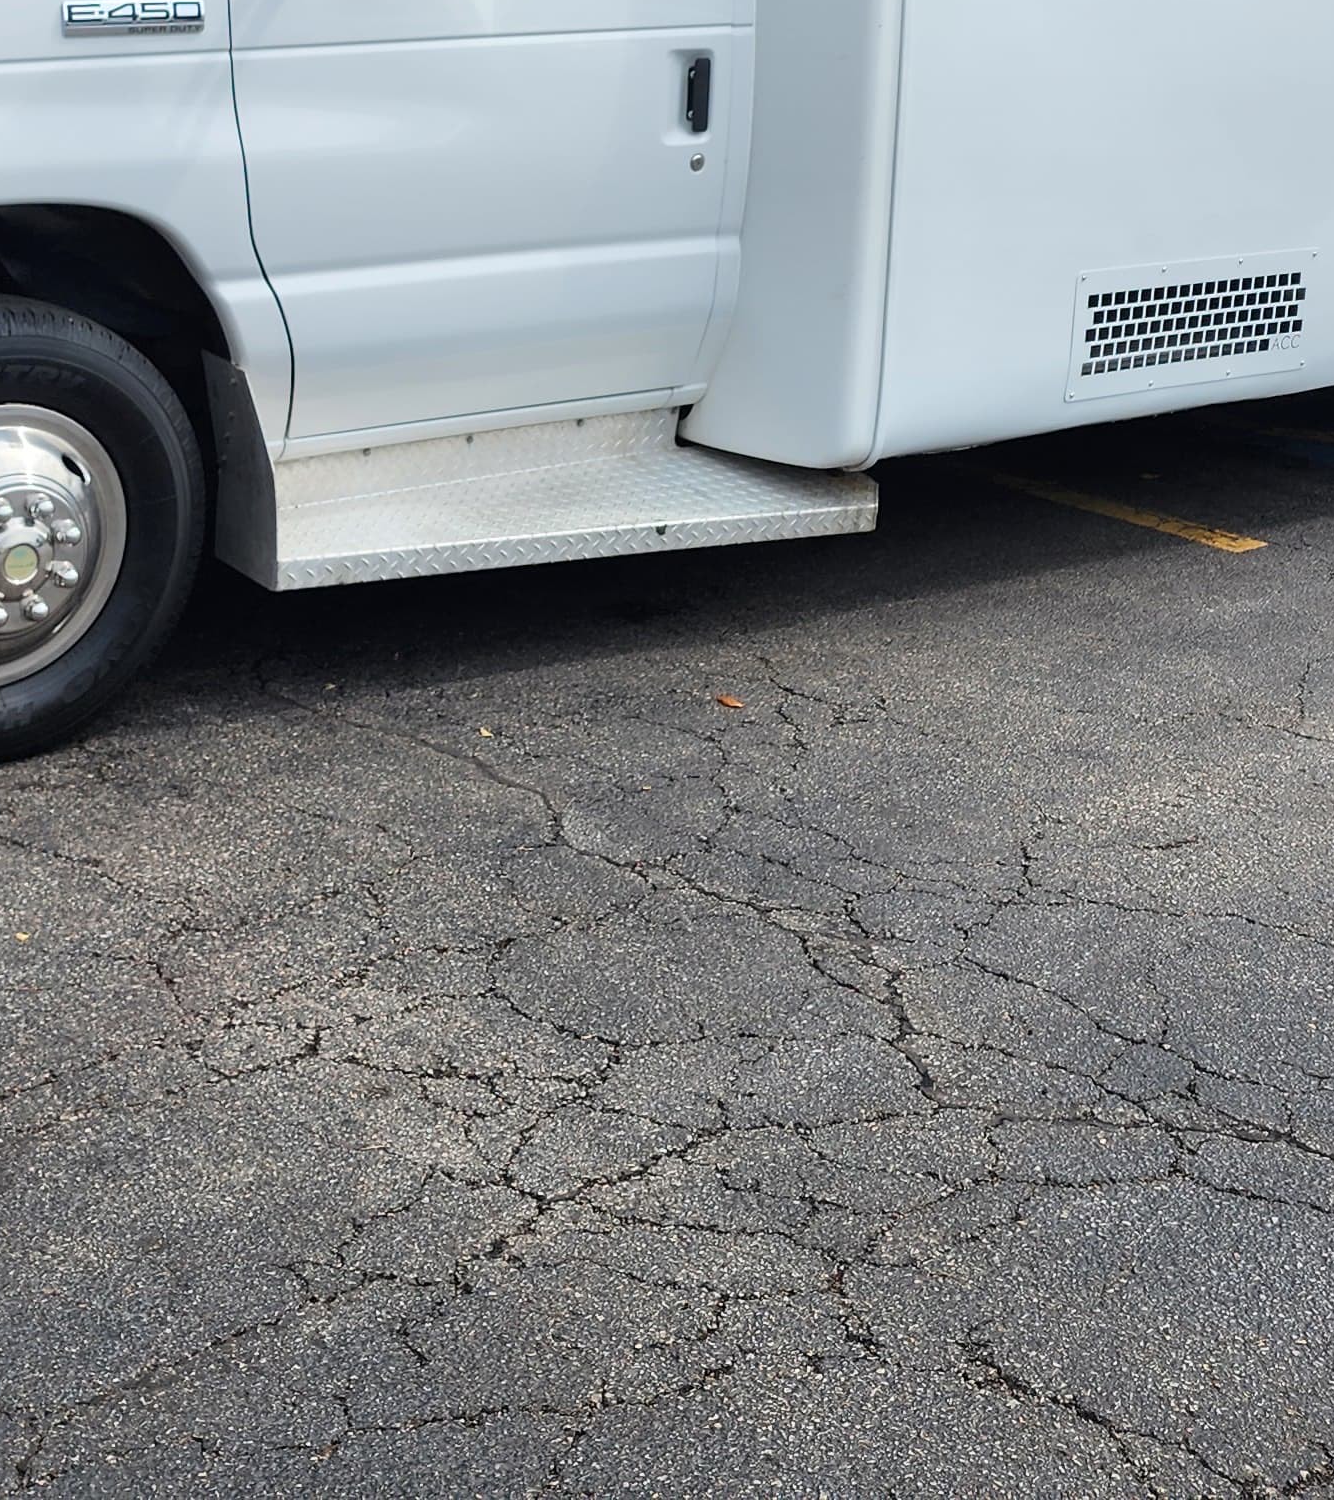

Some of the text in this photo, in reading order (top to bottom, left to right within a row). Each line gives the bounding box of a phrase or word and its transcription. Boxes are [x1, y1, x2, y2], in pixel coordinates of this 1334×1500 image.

[127, 24, 203, 35] SUPER DUTY
[1270, 334, 1301, 350] ACC
